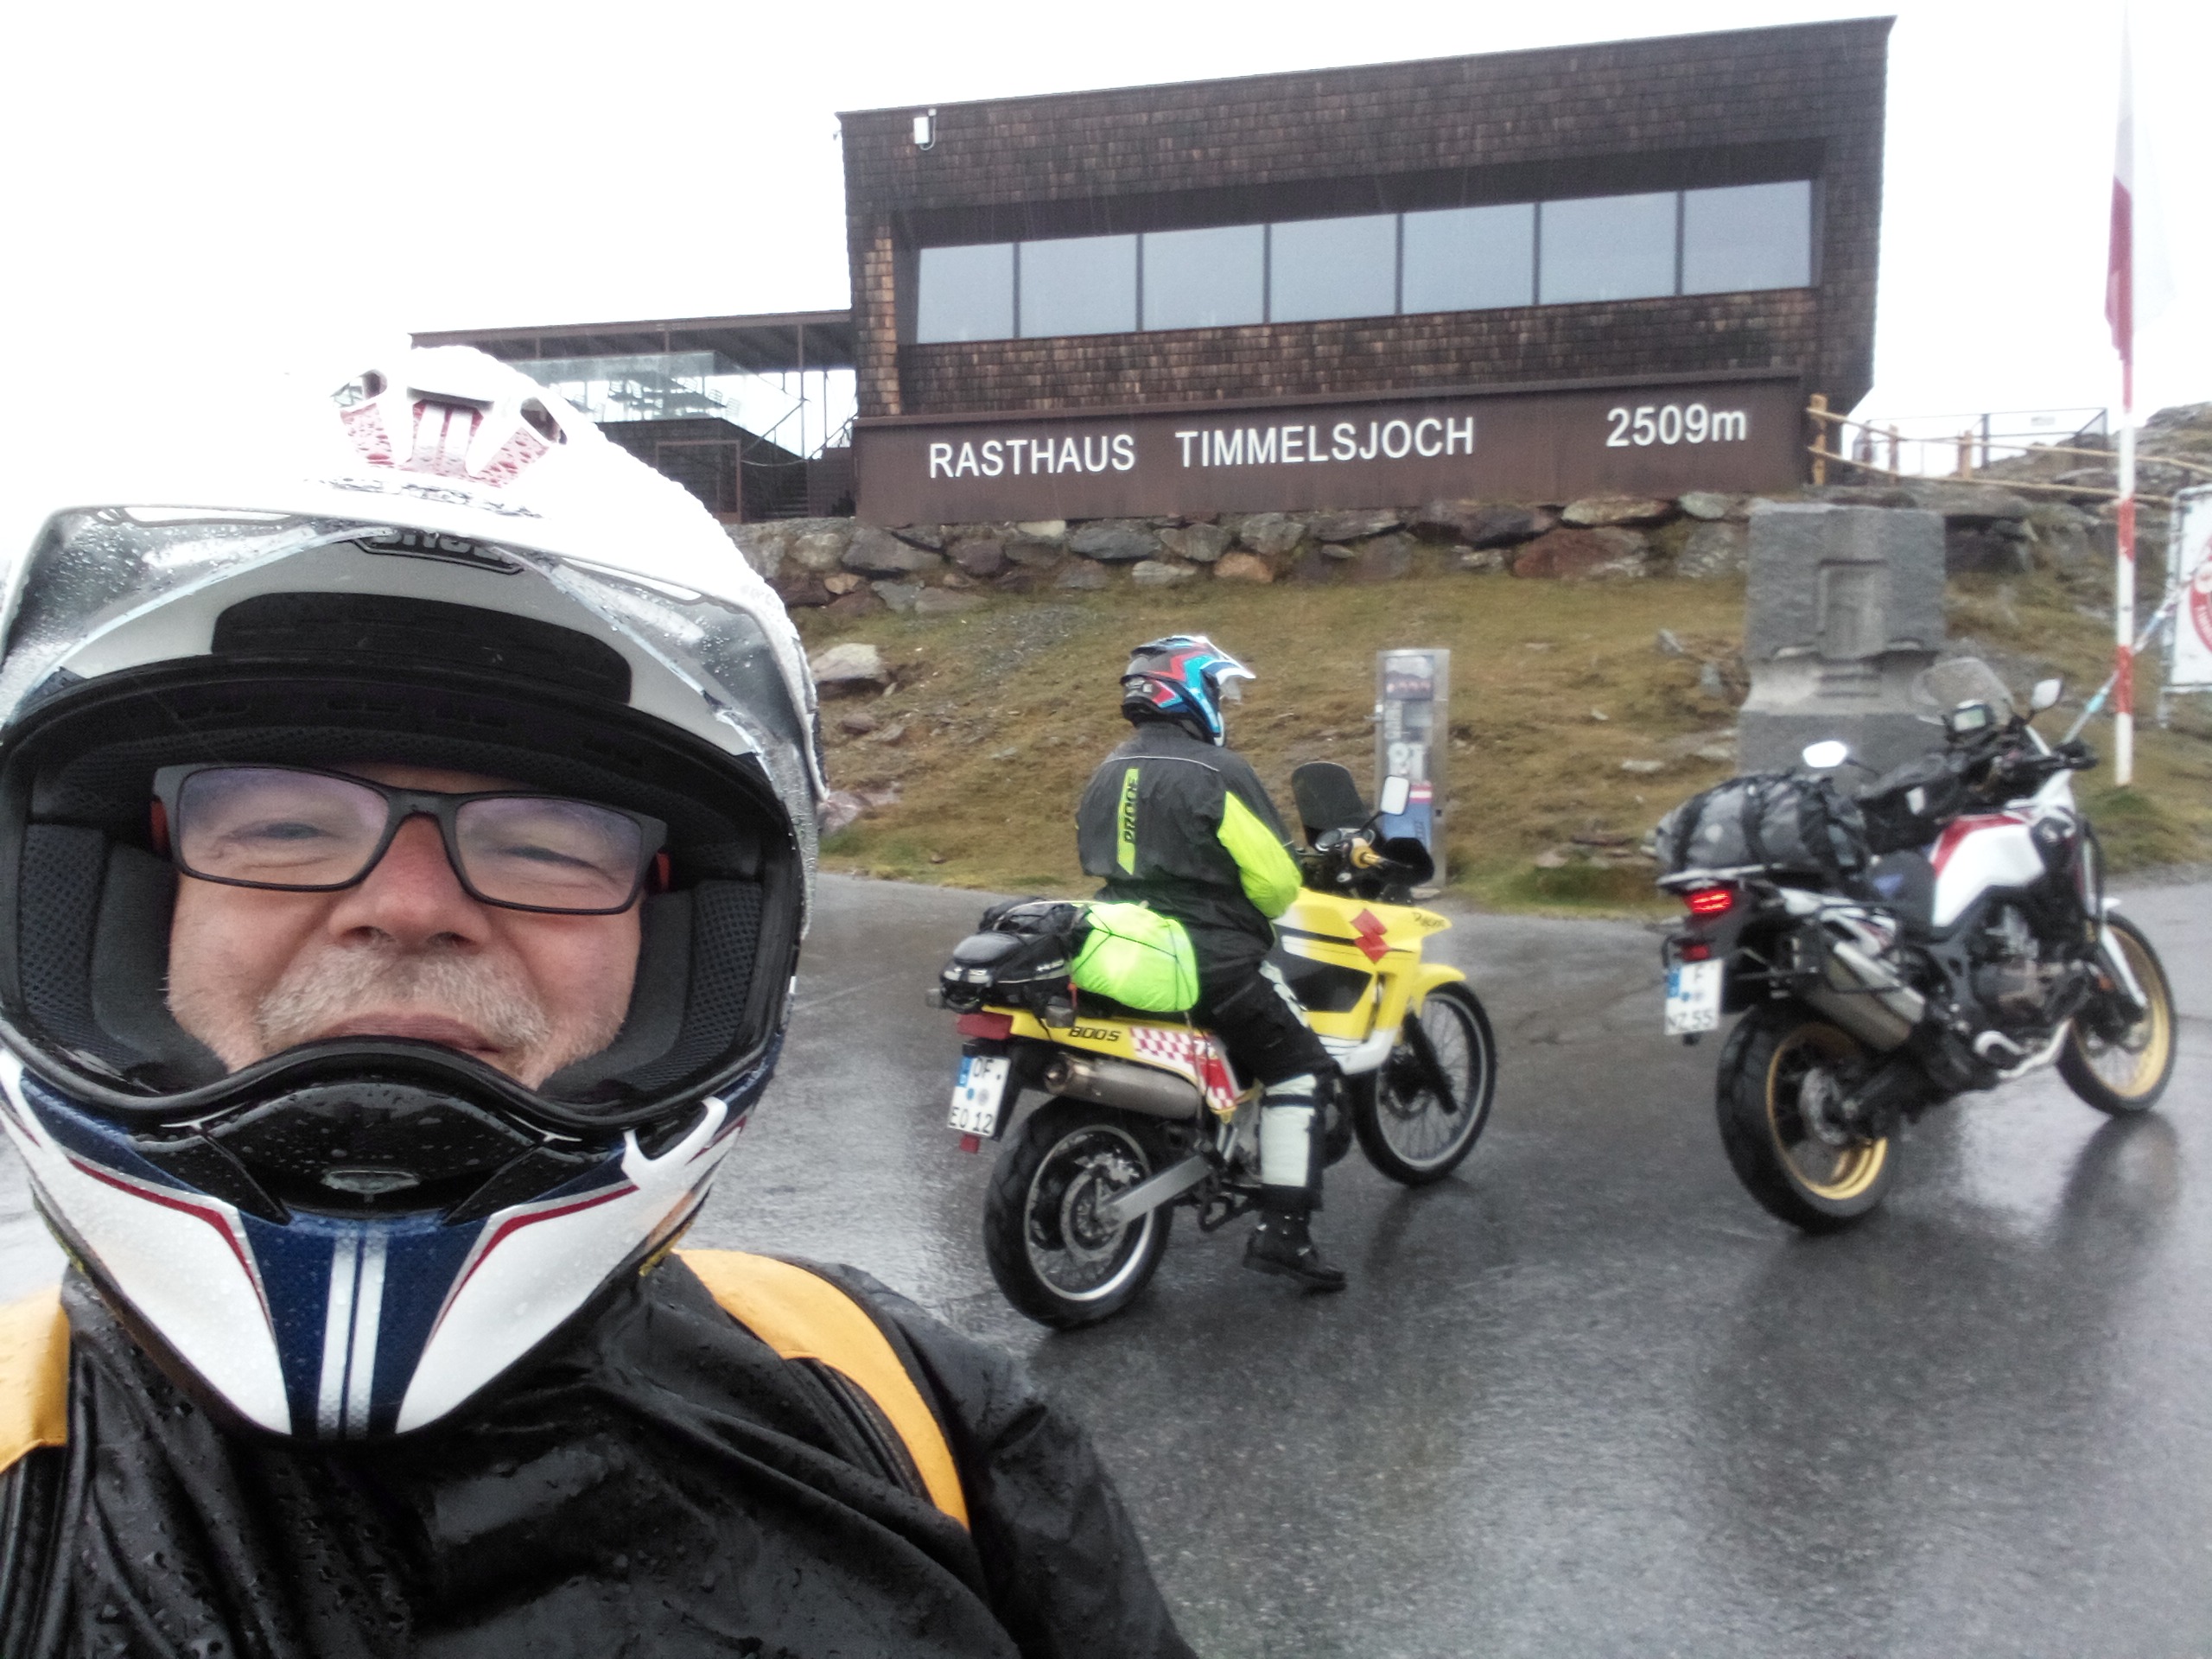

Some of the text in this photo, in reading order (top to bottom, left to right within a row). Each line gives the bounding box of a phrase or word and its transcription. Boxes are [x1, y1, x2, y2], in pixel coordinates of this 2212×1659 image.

[929, 416, 1475, 479] RASTHAUS TIMMELSJOCH
[1605, 404, 1747, 448] 2509m
[972, 1111, 994, 1135] 12
